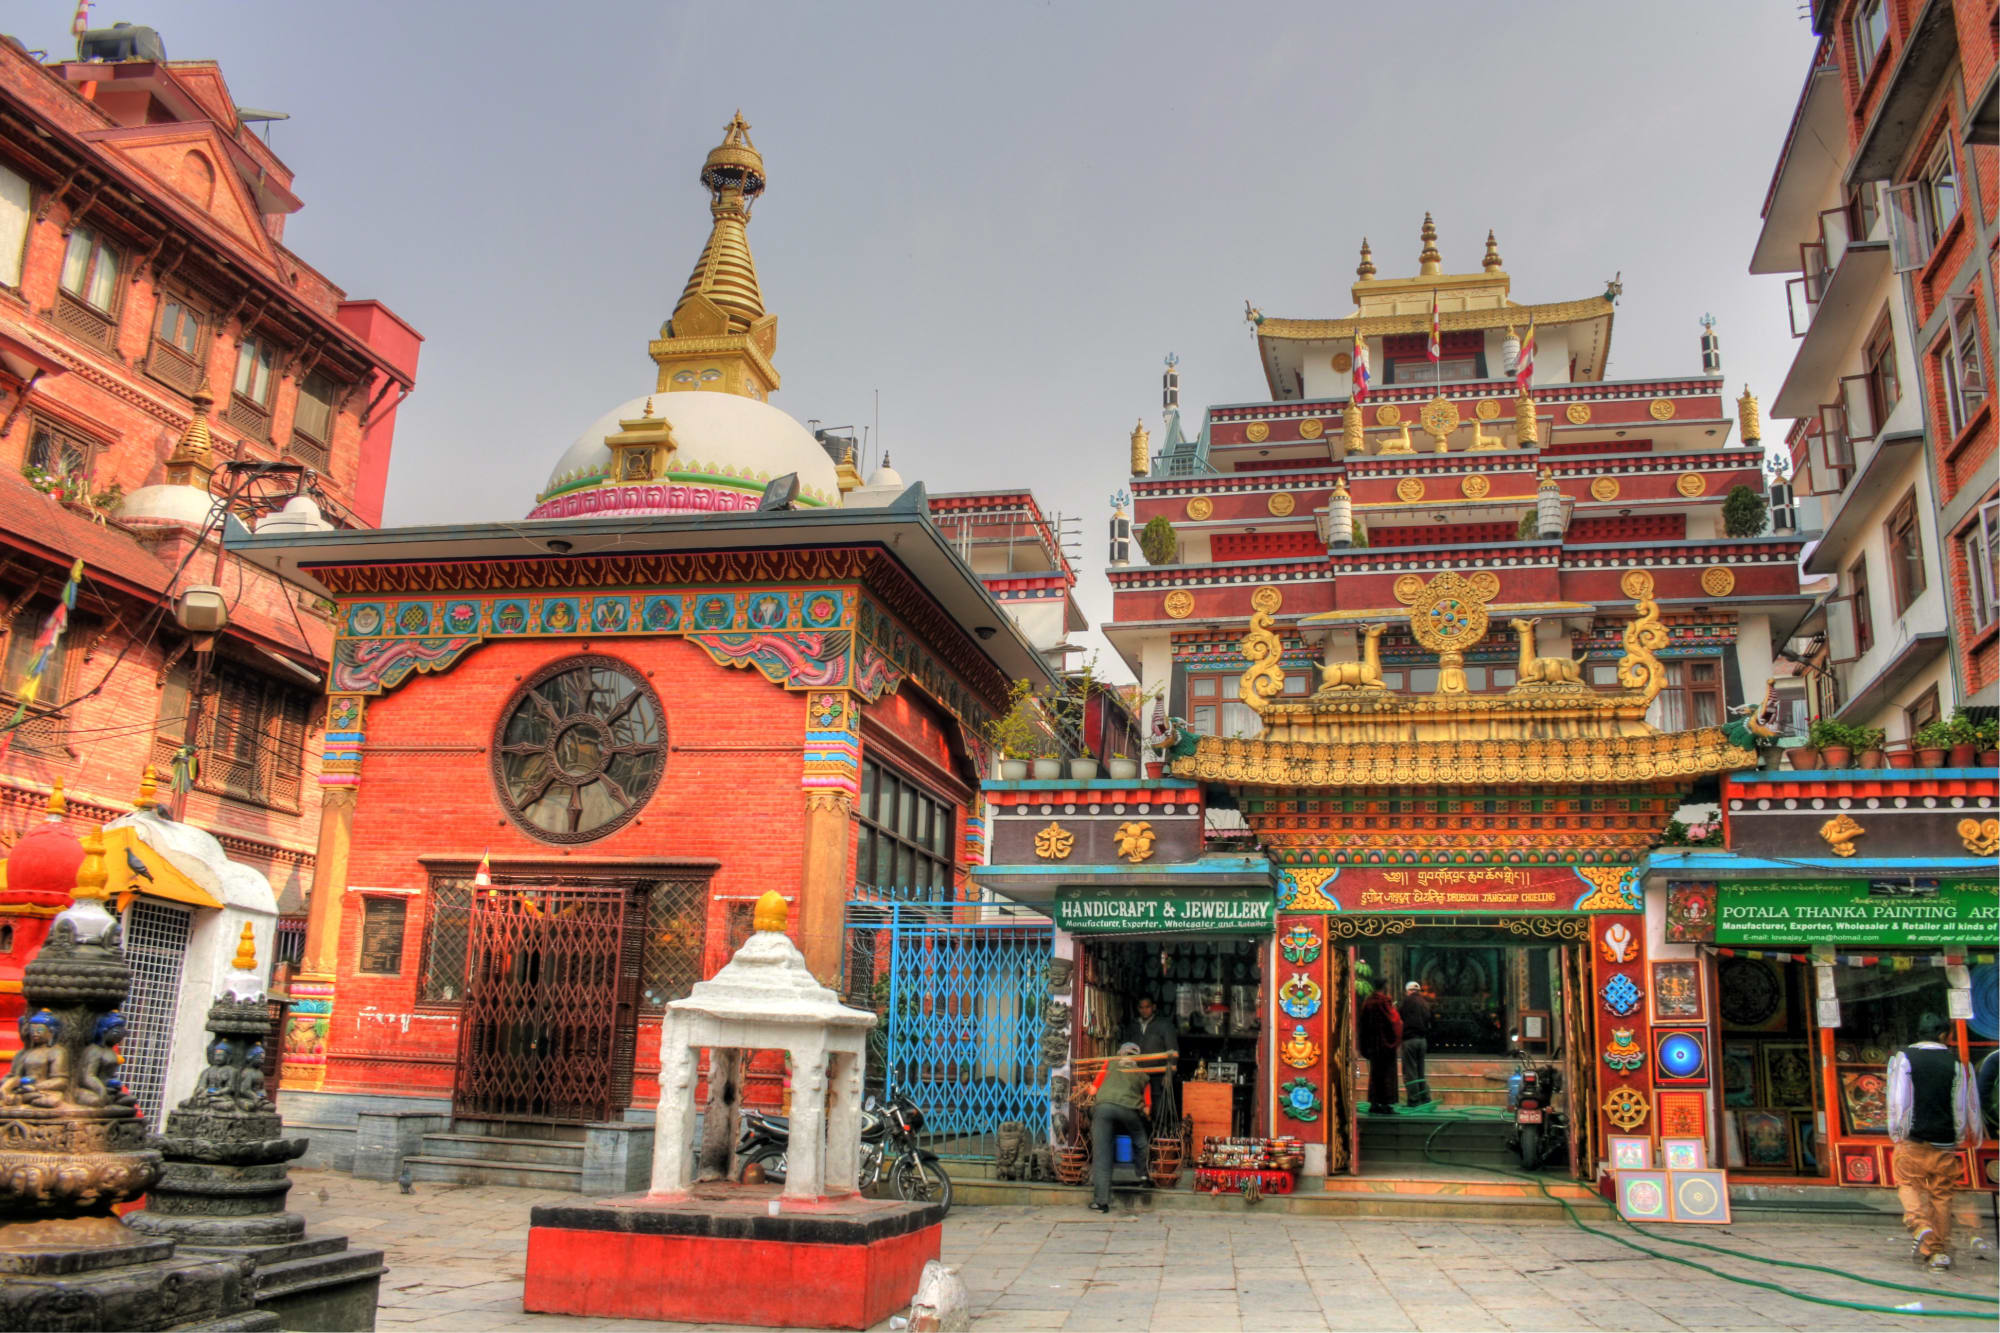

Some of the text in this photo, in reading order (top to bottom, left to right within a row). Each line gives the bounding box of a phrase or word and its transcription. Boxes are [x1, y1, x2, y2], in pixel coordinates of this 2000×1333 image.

[1061, 901, 1270, 919] HANDICRAFT & JEWELLERY
[1723, 907, 1790, 918] POTALA
[1795, 907, 1867, 918] THANKA
[1873, 907, 1958, 918] PAINTING
[1066, 919, 1121, 929] Manufacturer,
[1164, 920, 1216, 929] Wholesaler
[1218, 920, 1234, 929] and
[1722, 922, 1998, 931] Manufacturer, Exporter, Wholesaler & Retailer all kinds of
